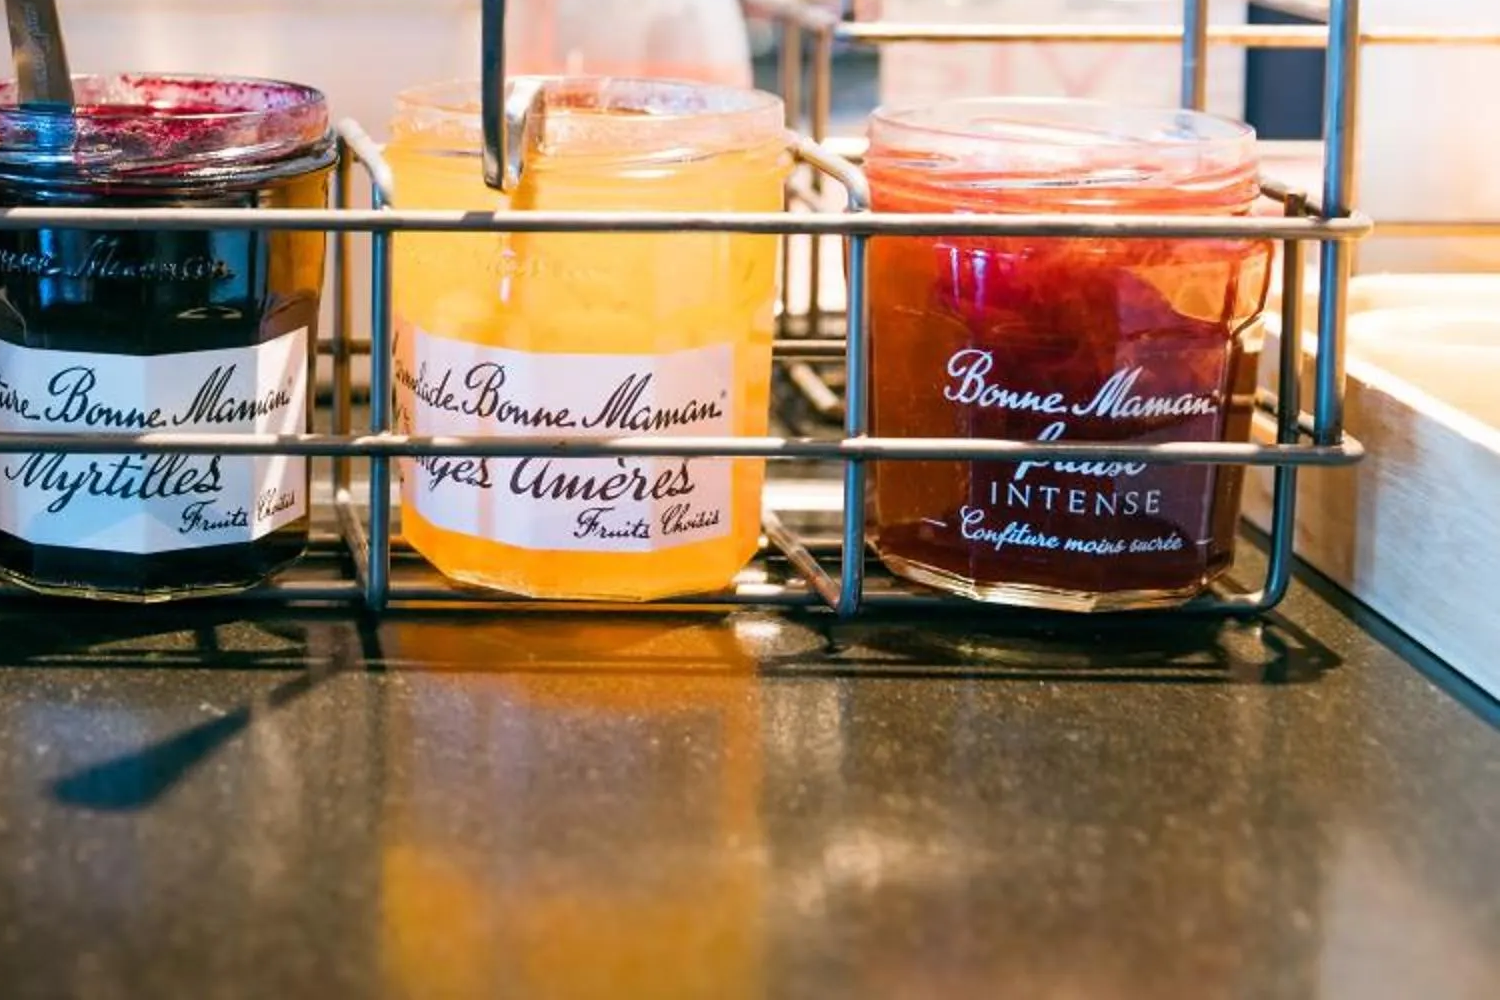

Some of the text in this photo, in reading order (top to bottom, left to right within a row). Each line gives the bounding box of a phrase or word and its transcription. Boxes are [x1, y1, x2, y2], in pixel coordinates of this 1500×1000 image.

[44, 366, 167, 428] Bonne
[172, 364, 290, 425] Maman
[462, 361, 576, 428] Bonne
[582, 372, 722, 431] Maman
[944, 349, 1217, 419] Bonne Maman
[5, 452, 223, 513] Myrtilles
[990, 481, 1162, 517] INTENSE
[179, 499, 249, 534] Fruits
[573, 503, 720, 539] Fruits Choisis
[959, 505, 1183, 555] Confiture moins sucrée
